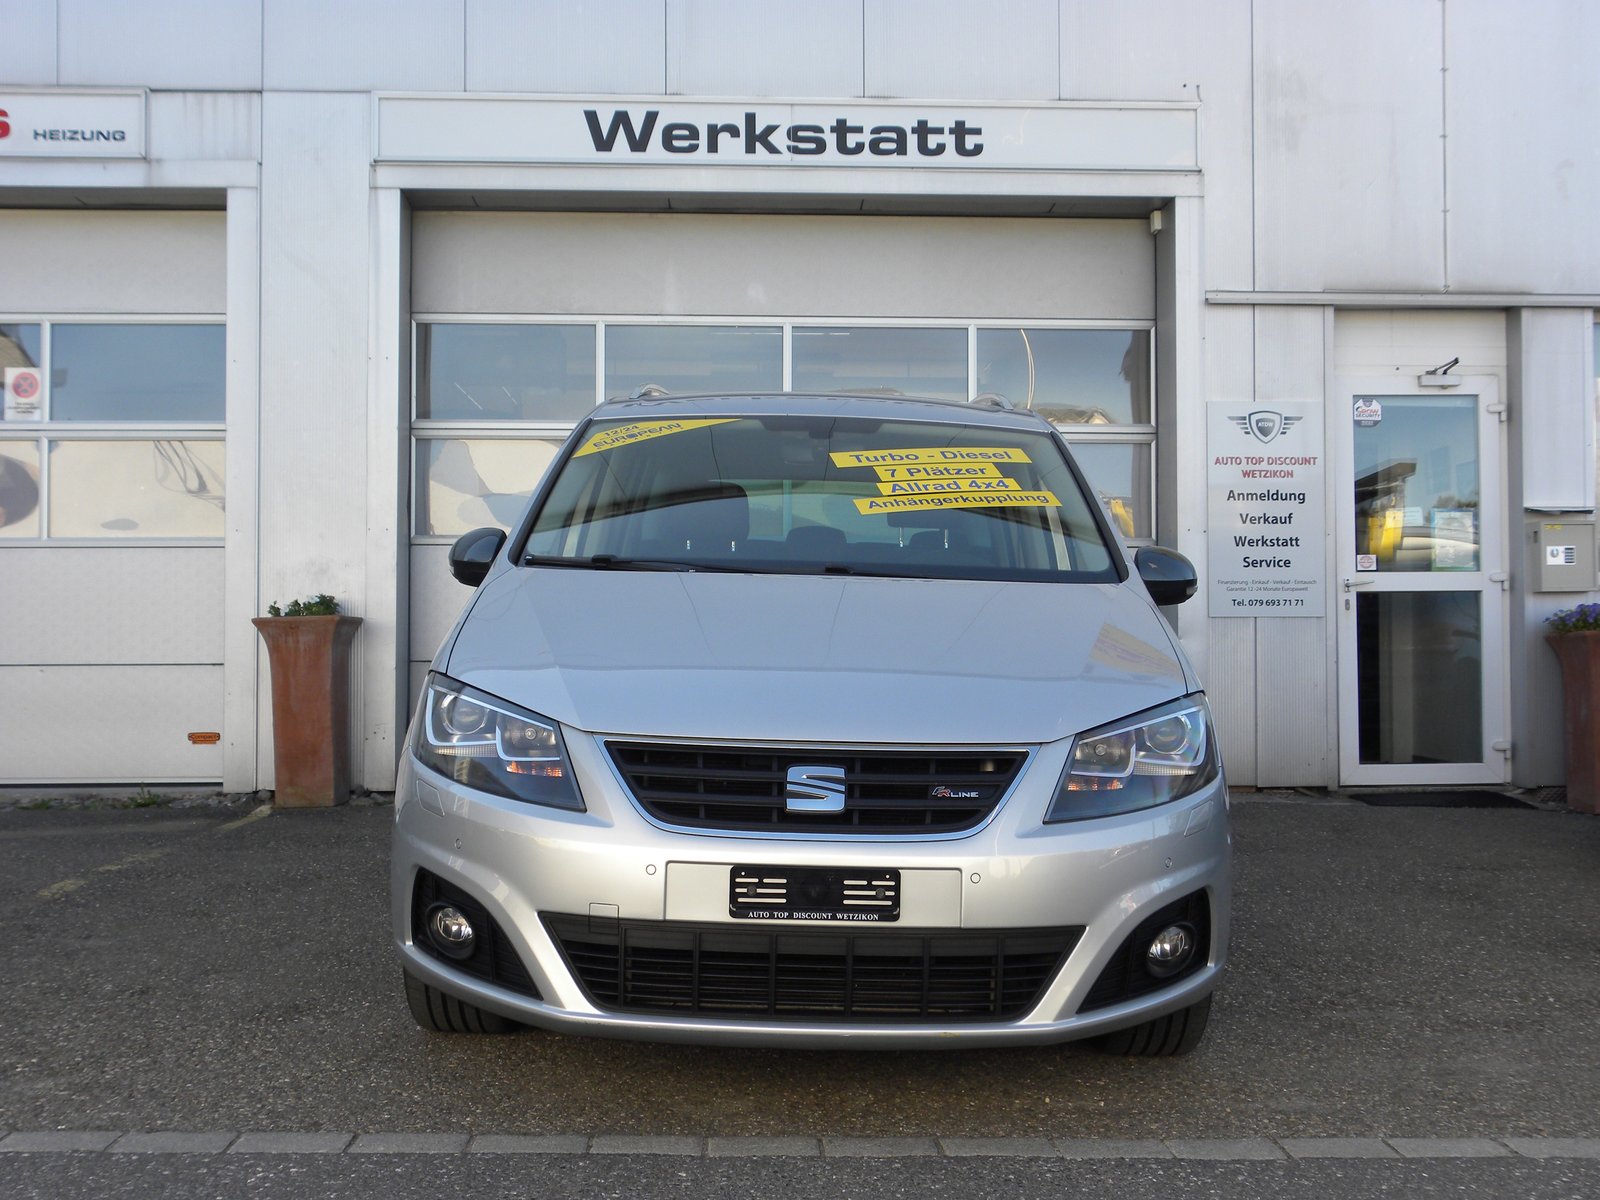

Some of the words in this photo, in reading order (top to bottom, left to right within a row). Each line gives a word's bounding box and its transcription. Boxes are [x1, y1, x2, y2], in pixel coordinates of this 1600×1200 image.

[33, 129, 126, 141] HEIZUNG
[583, 109, 984, 157] Werkstatt
[592, 422, 682, 448] EUROPEAN
[604, 425, 640, 437] 12/24
[850, 453, 920, 464] Turbo
[940, 450, 1012, 461] Diesel
[1214, 456, 1242, 466] AUTO
[1244, 456, 1265, 466] TOP
[1267, 456, 1318, 466] DISCOUNT
[884, 468, 897, 478] 7
[906, 465, 987, 477] Plätzer
[1241, 469, 1294, 479] WETZIKON
[891, 479, 962, 494] Allrad
[968, 479, 1010, 490] 4x4
[868, 493, 1050, 510] Anhängerkupplung
[1227, 489, 1306, 504] Anmeldung
[1239, 512, 1294, 525] Verkauf
[1234, 535, 1300, 547] Werkstatt
[1243, 556, 1292, 568] Service
[1231, 598, 1247, 607] Tel.
[1248, 598, 1264, 607] 079
[1265, 598, 1281, 607] 693
[1282, 599, 1292, 607] 71
[1294, 599, 1304, 607] 71
[748, 911, 770, 919] AUTO
[793, 912, 833, 920] DISCOUNT
[836, 913, 879, 921] WETZIKON
